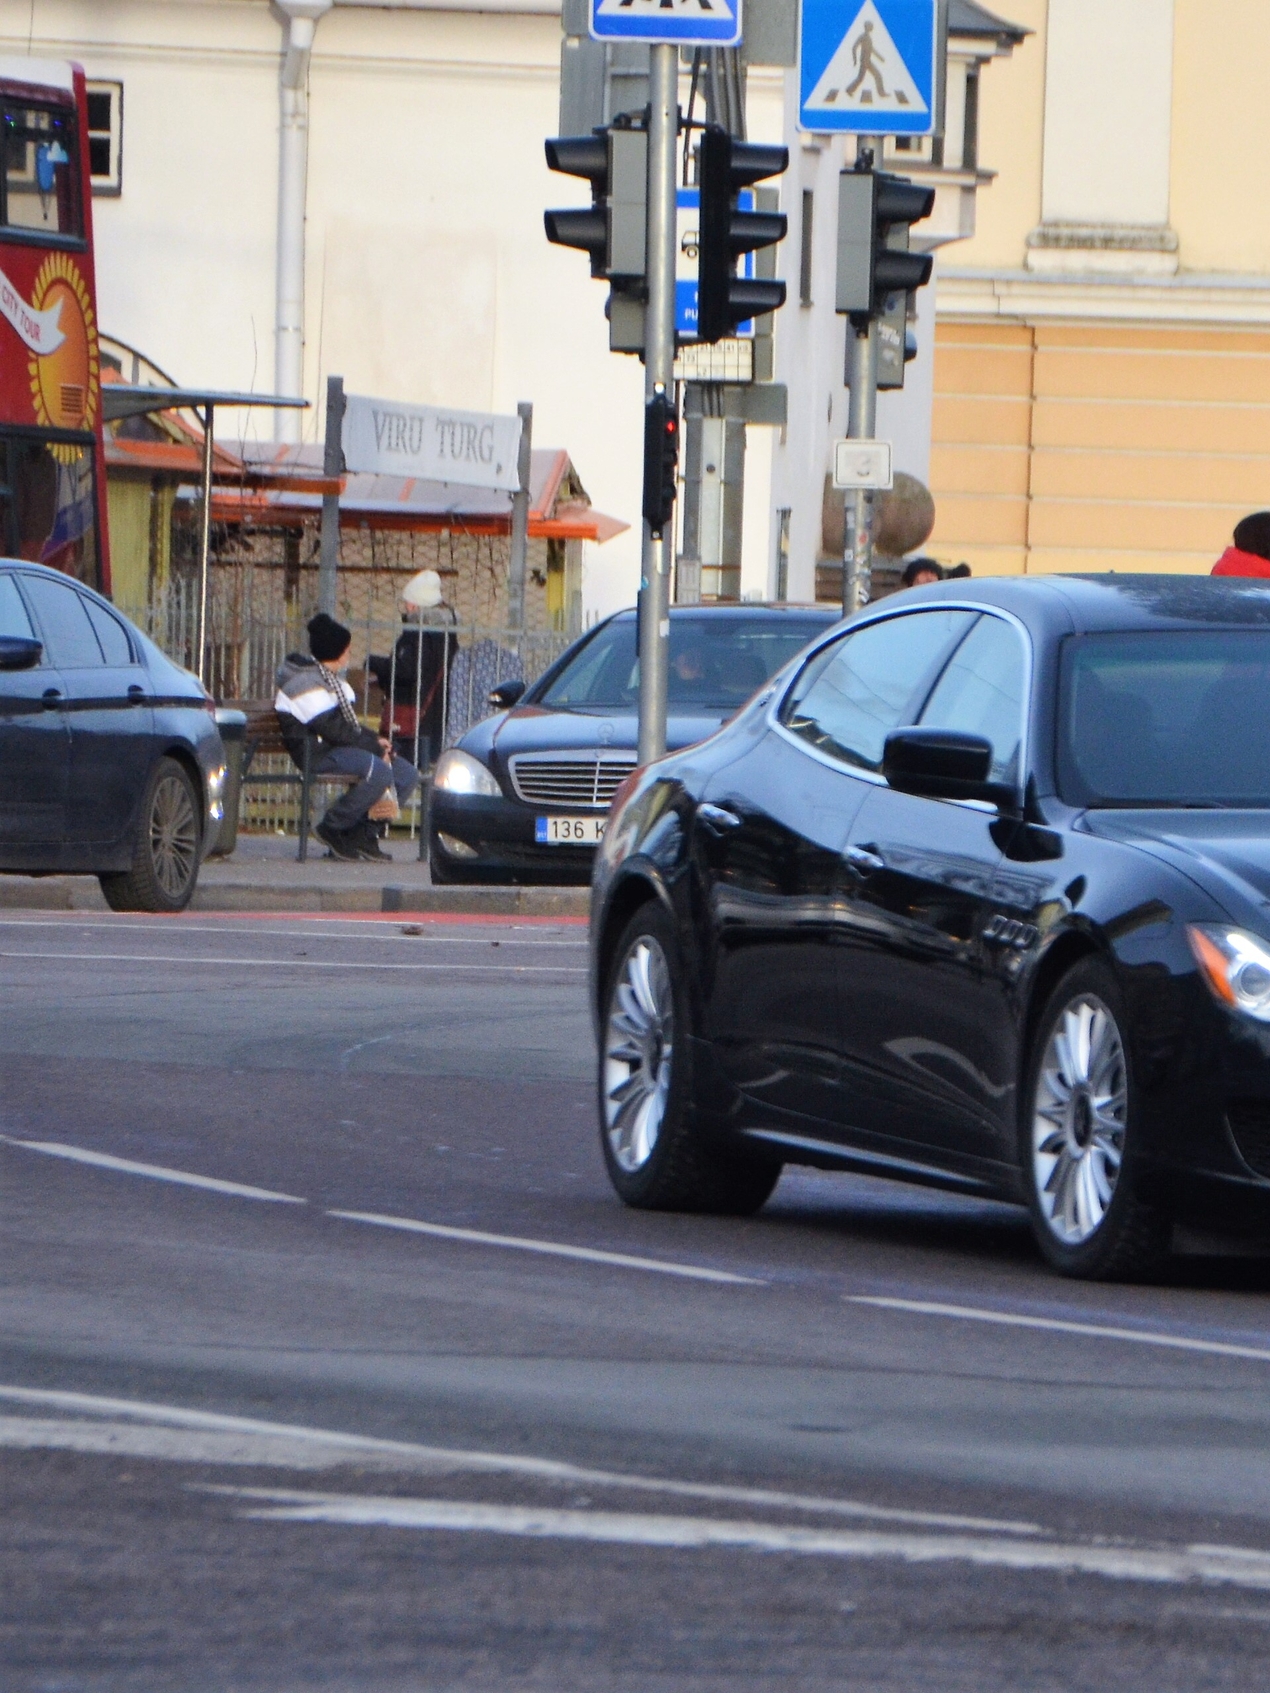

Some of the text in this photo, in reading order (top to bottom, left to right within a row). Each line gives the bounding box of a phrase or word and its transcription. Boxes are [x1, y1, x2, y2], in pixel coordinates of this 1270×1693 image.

[19, 307, 41, 343] TOUR
[372, 409, 495, 464] VIRU TURG
[553, 820, 584, 839] 136
